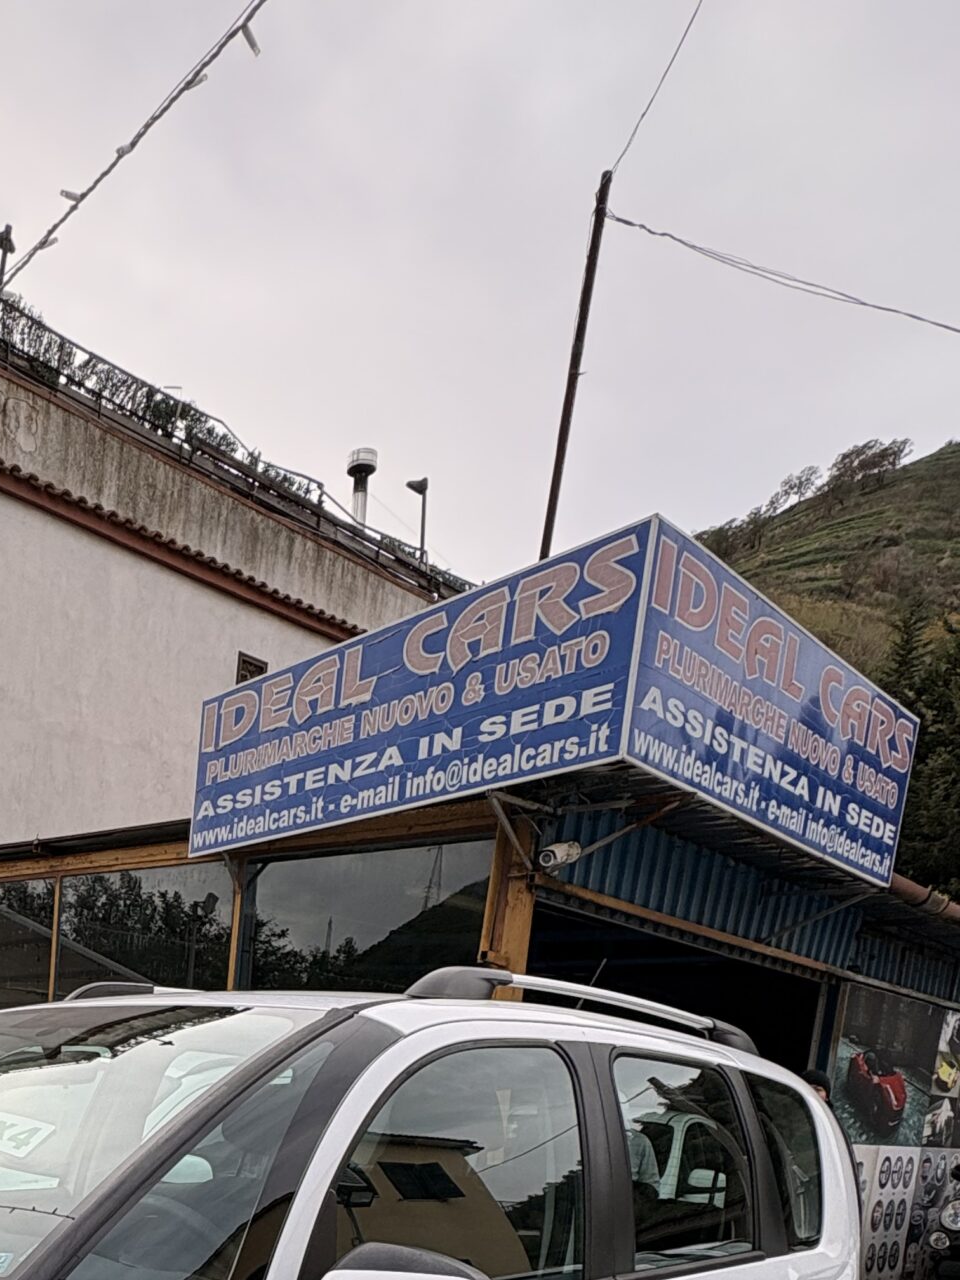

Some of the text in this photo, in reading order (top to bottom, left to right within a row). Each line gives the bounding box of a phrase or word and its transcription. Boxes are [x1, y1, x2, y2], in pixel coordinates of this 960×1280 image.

[201, 534, 640, 753] IDEAL CARS
[206, 630, 611, 786] PLURIMARCHE NUOVO & USATO
[651, 534, 914, 774] IDEAL CARS
[654, 630, 899, 810] PLURIMARCHE NUOVO & USATO
[193, 797, 324, 849] www.idealcars.it
[340, 774, 401, 814] e-mail
[405, 722, 611, 799] info@idealcars.it
[196, 682, 616, 822] ASSISTENZA IN SEDE
[633, 728, 761, 814] www.idealcars.it
[767, 798, 806, 836] e-mail
[805, 813, 892, 878] info@idealcars.it
[639, 685, 897, 847] ASSISTENZA IN SEDE
